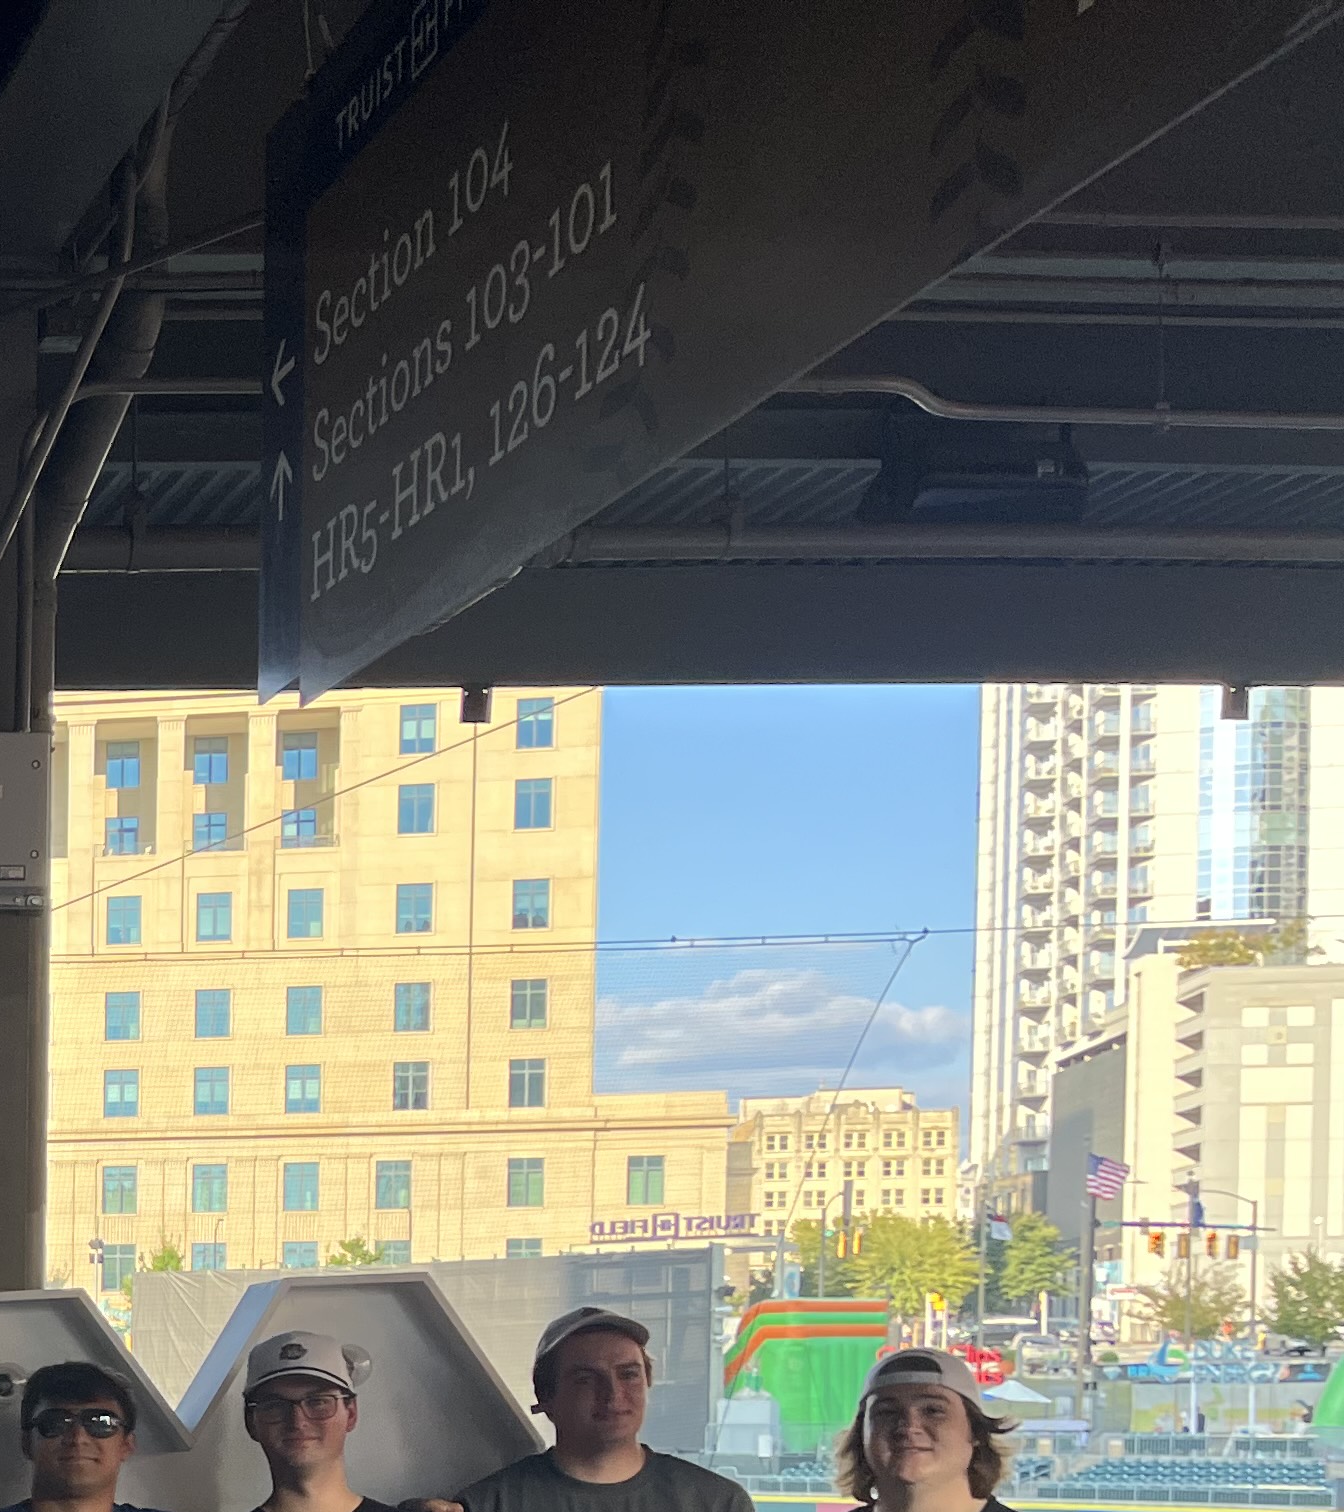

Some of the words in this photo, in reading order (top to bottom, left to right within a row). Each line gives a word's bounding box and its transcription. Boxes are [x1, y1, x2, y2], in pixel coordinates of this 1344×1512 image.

[335, 35, 410, 151] TRUIST
[313, 319, 453, 482] Sections
[464, 160, 617, 352] 103-101
[314, 228, 436, 366] Section
[448, 117, 513, 237] 104
[311, 432, 476, 603] HR5-HR1,
[488, 281, 652, 467] 126-124
